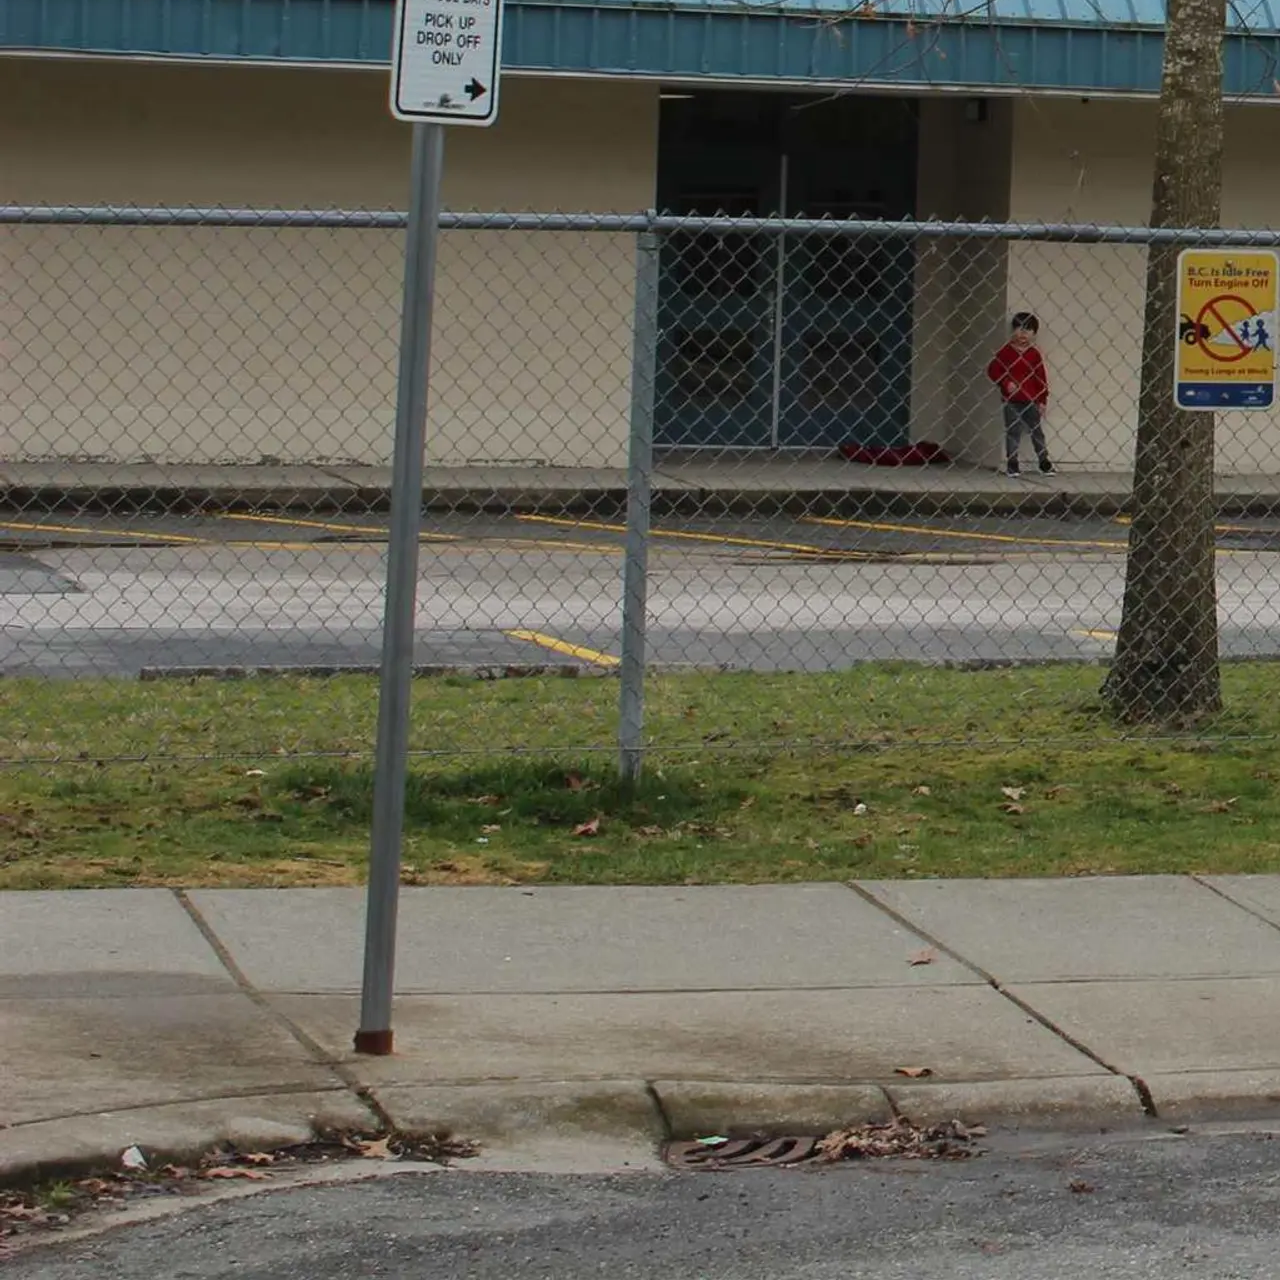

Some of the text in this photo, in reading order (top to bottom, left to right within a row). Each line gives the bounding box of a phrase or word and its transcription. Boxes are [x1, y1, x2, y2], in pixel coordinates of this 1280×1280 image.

[424, 13, 476, 30] PICK UP
[416, 30, 481, 49] DROP OFF
[432, 49, 464, 66] ONLY
[1222, 266, 1244, 277] Idle
[1245, 267, 1270, 277] Free
[1188, 277, 1269, 290] Turn Engine Off
